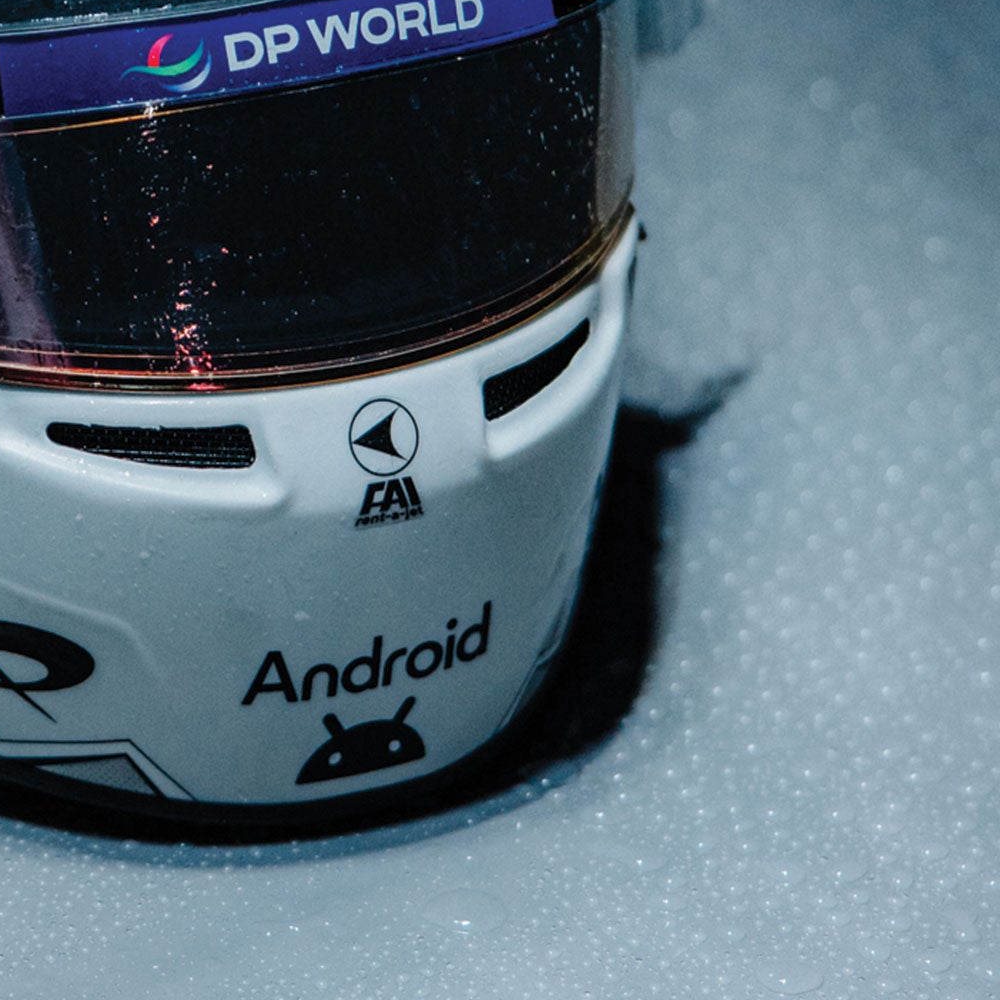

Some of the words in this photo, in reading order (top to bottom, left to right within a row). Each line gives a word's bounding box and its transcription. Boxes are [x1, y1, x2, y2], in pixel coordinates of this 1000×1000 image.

[224, 23, 299, 72] DP
[359, 476, 422, 516] FAI
[241, 600, 492, 706] Android
